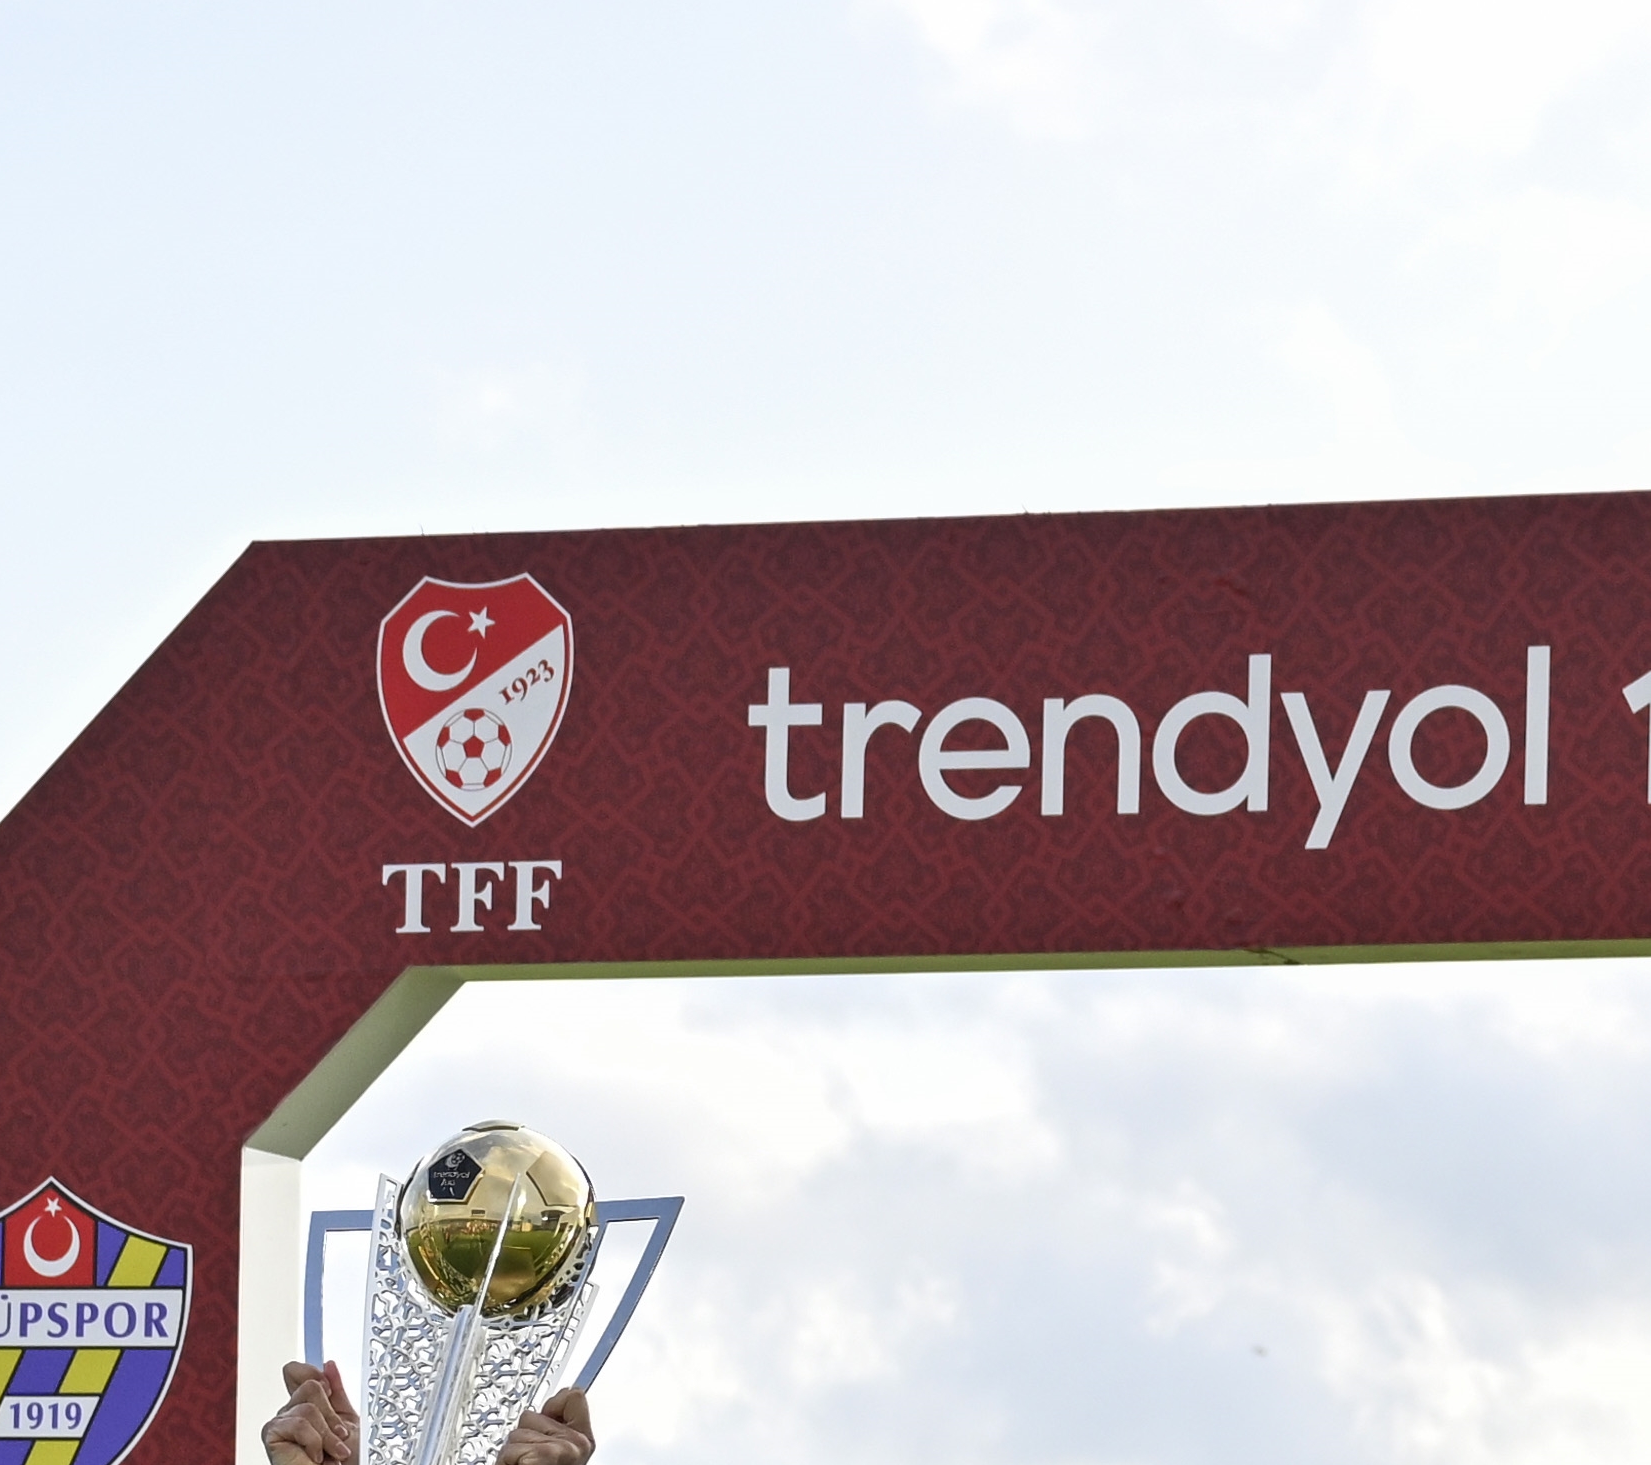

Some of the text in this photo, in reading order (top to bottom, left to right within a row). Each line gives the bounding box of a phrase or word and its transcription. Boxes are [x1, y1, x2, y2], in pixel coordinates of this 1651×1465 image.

[499, 657, 555, 706] 1923
[748, 646, 1550, 849] trendyol
[383, 861, 562, 934] TFF
[10, 1403, 83, 1433] 1919
